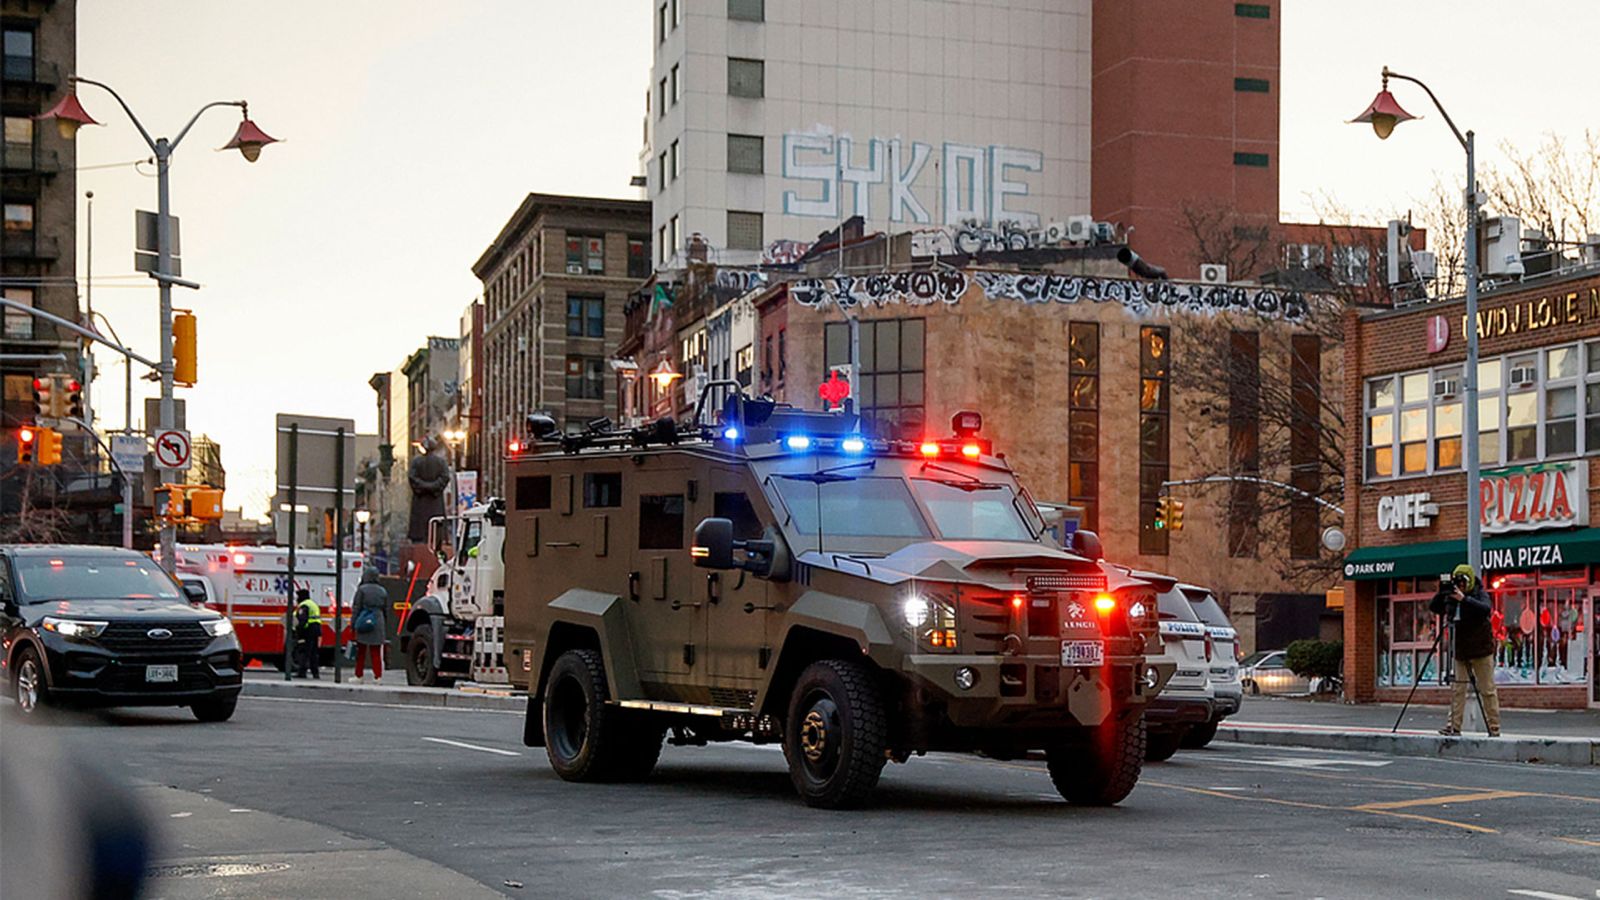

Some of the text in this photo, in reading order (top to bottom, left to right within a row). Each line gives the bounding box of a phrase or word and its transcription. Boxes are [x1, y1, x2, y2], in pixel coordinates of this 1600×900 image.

[1378, 492, 1431, 531] CAFE
[1480, 471, 1574, 526] PIZZA
[1355, 562, 1395, 574] PARK ROW
[1480, 544, 1563, 570] UNA PIZZA
[1167, 622, 1200, 633] POLICE
